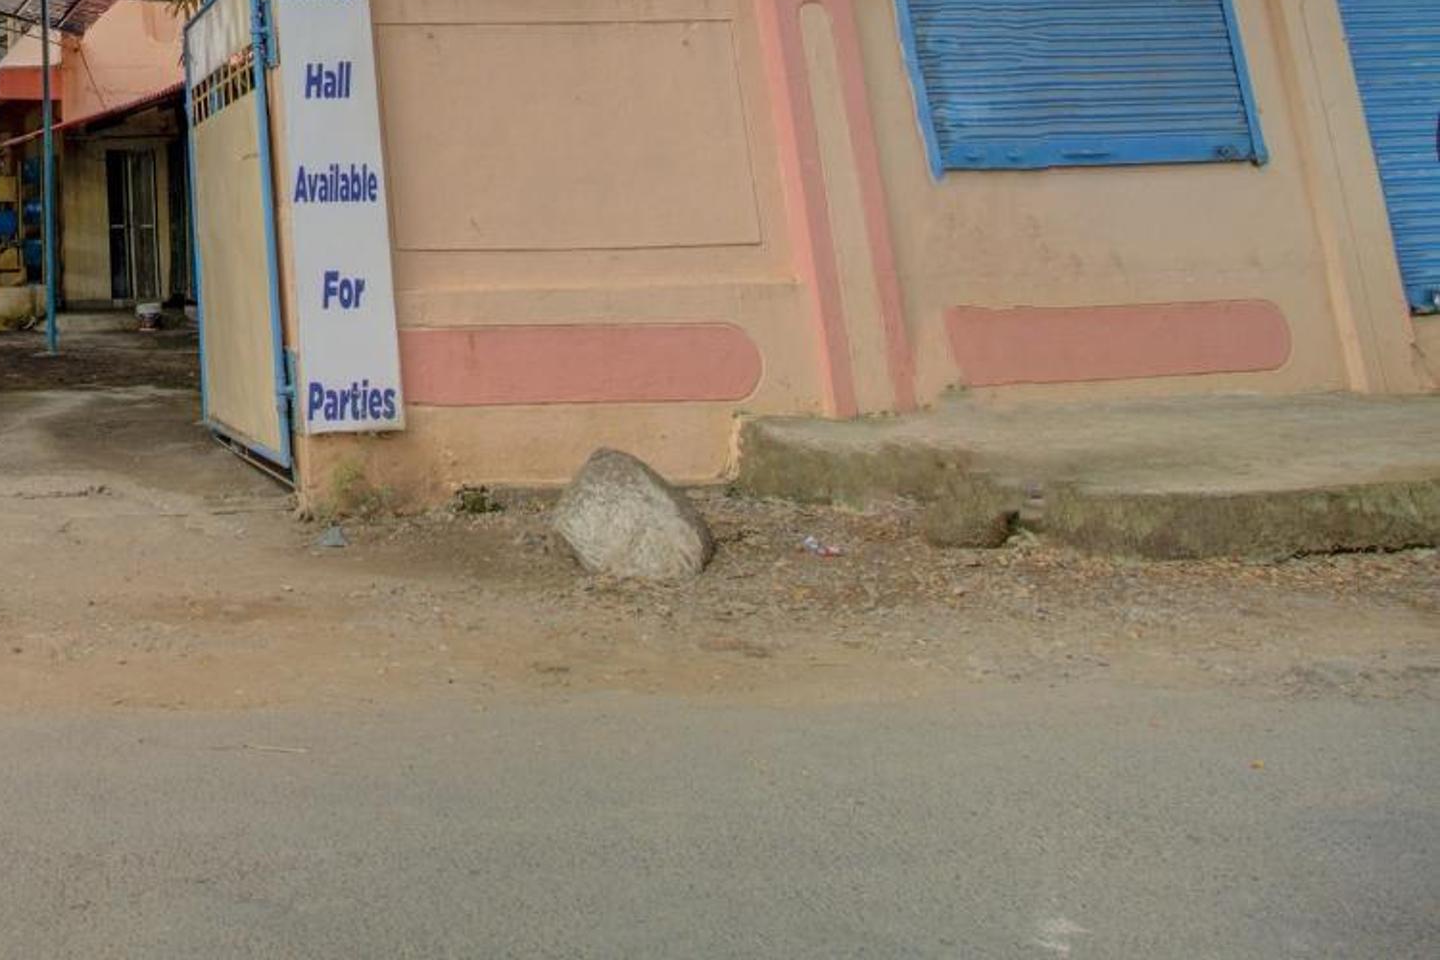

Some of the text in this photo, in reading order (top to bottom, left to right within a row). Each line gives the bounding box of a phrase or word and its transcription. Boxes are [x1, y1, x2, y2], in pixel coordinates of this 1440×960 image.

[304, 61, 352, 100] Hall
[293, 163, 379, 204] Available
[322, 270, 366, 310] For
[307, 379, 397, 423] Parties
